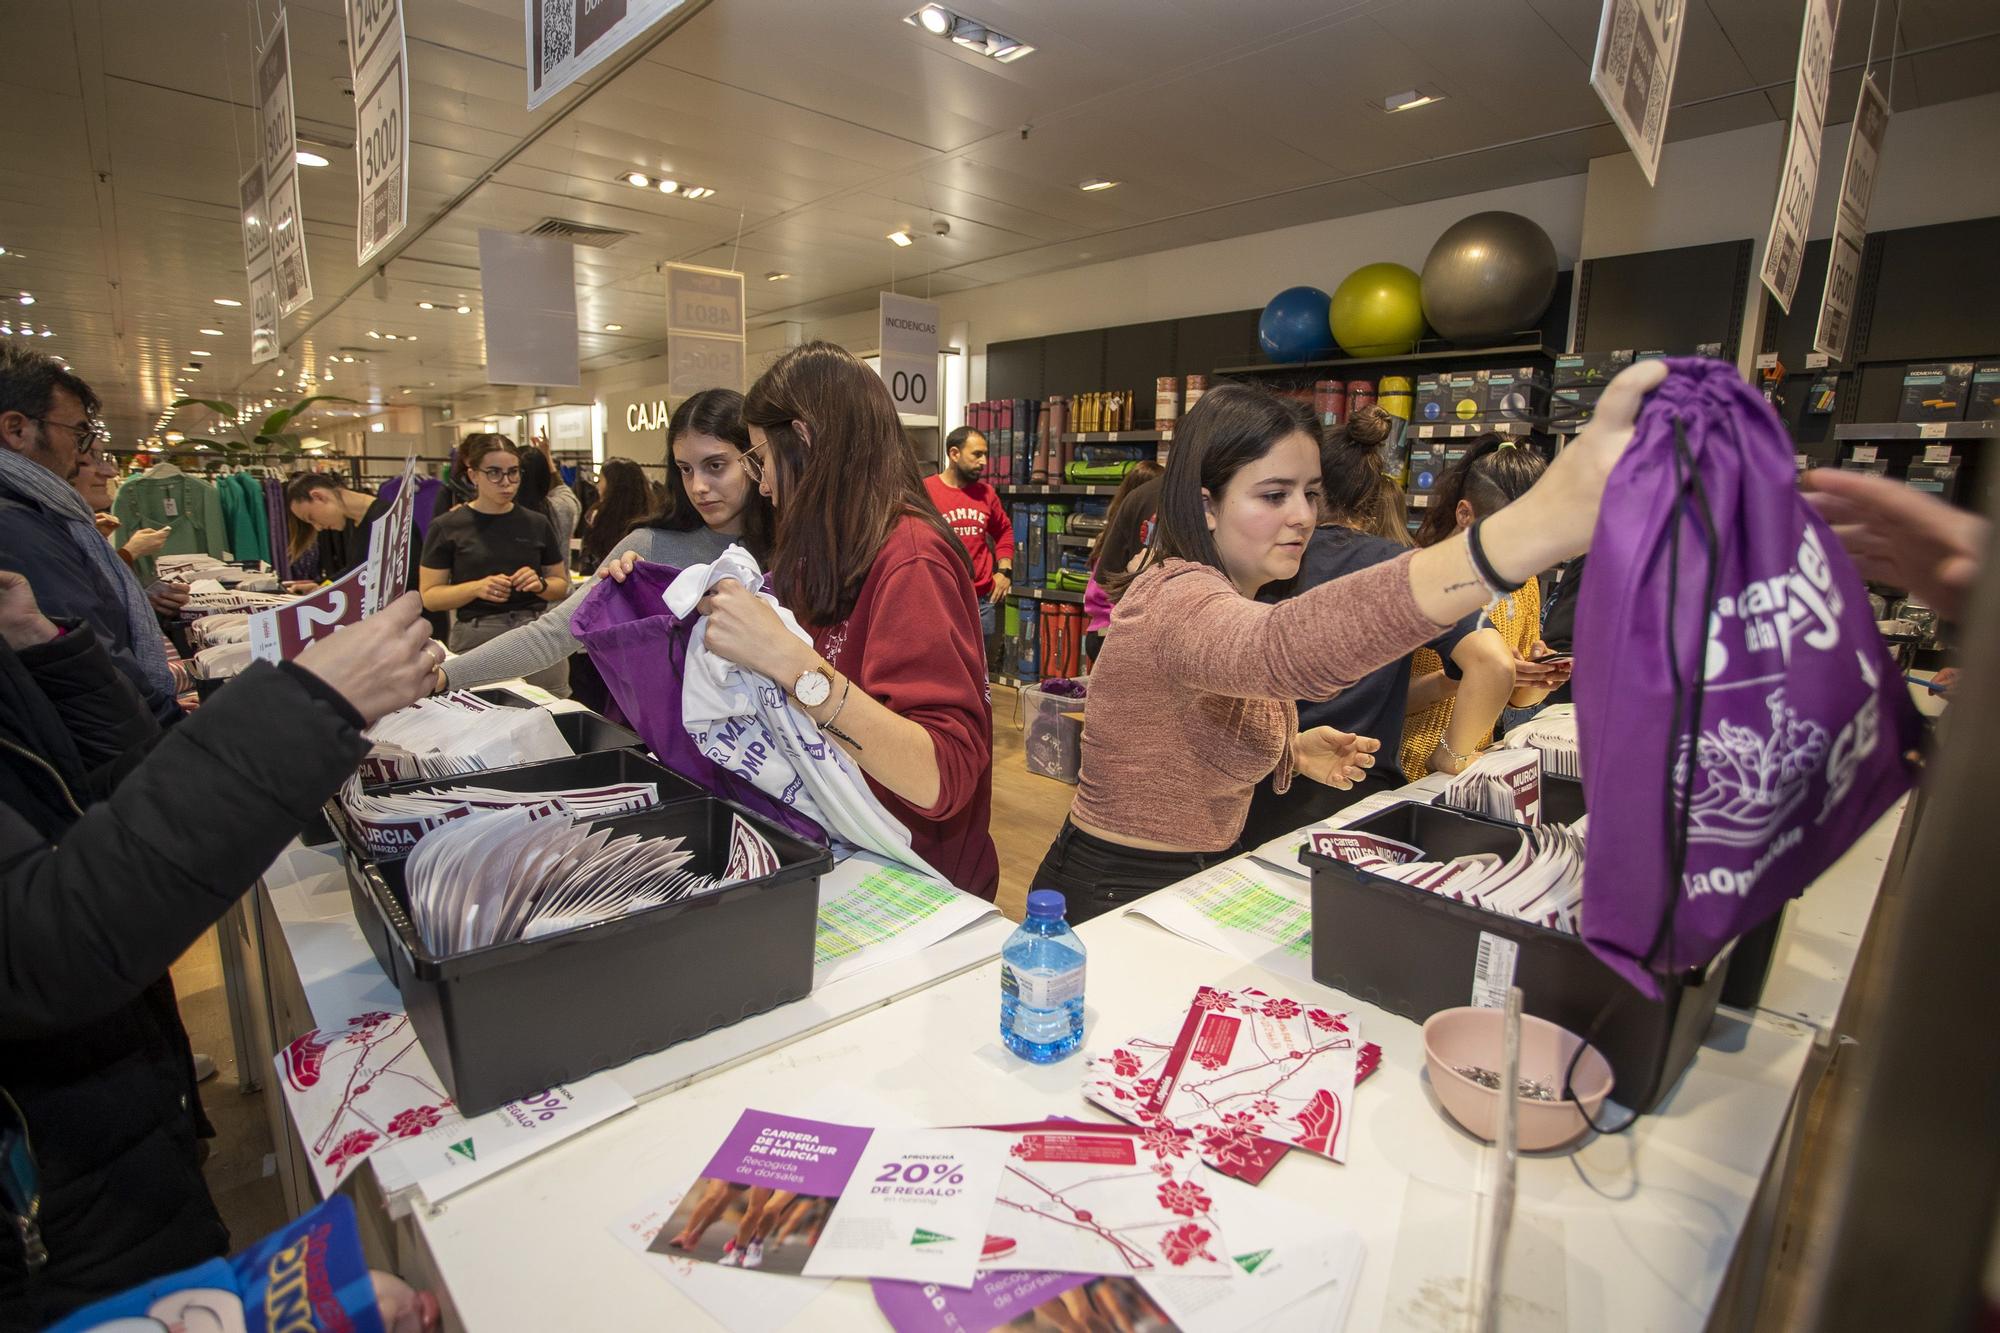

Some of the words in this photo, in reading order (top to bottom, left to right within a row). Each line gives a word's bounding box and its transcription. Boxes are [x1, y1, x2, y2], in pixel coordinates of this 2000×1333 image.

[267, 108, 288, 163] 3001
[360, 108, 397, 187] 3000
[1786, 165, 1809, 238] 1200
[885, 316, 937, 335] INCIDENCIAS
[892, 371, 926, 403] 00
[626, 401, 669, 432] CAJA
[953, 527, 978, 536] FIVE
[755, 1135, 775, 1146] DE
[774, 1138, 792, 1149] LA
[793, 1142, 838, 1156] MUJER
[761, 1127, 820, 1144] CARRERA
[749, 1144, 770, 1154] DE
[769, 1147, 820, 1163] MURCIA
[737, 1164, 752, 1175] de
[754, 1168, 805, 1183] dorsales
[742, 1155, 798, 1173] Recogida
[874, 1163, 965, 1185] 20%
[870, 1186, 892, 1195] DE
